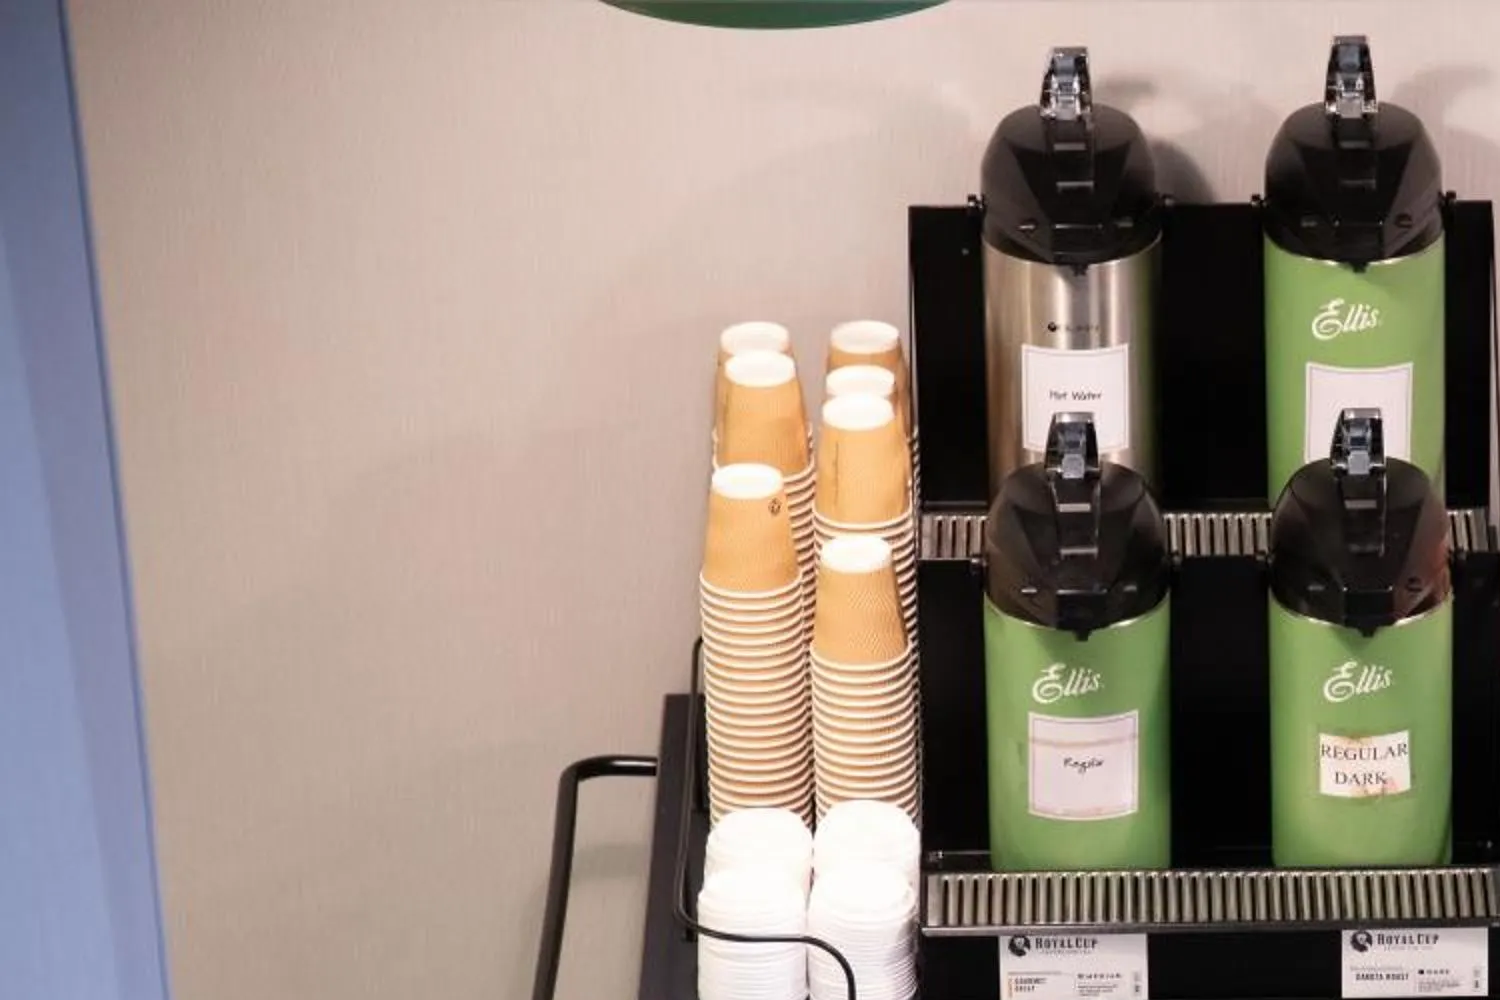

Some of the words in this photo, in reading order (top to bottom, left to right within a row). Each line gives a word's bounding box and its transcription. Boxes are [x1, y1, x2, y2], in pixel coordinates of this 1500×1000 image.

[1311, 297, 1380, 341] Ellis
[1071, 390, 1102, 401] Water
[1032, 662, 1102, 704] Ellis
[1323, 660, 1393, 703] Ellis
[1320, 742, 1408, 761] REGULAR
[1334, 770, 1388, 786] DARK
